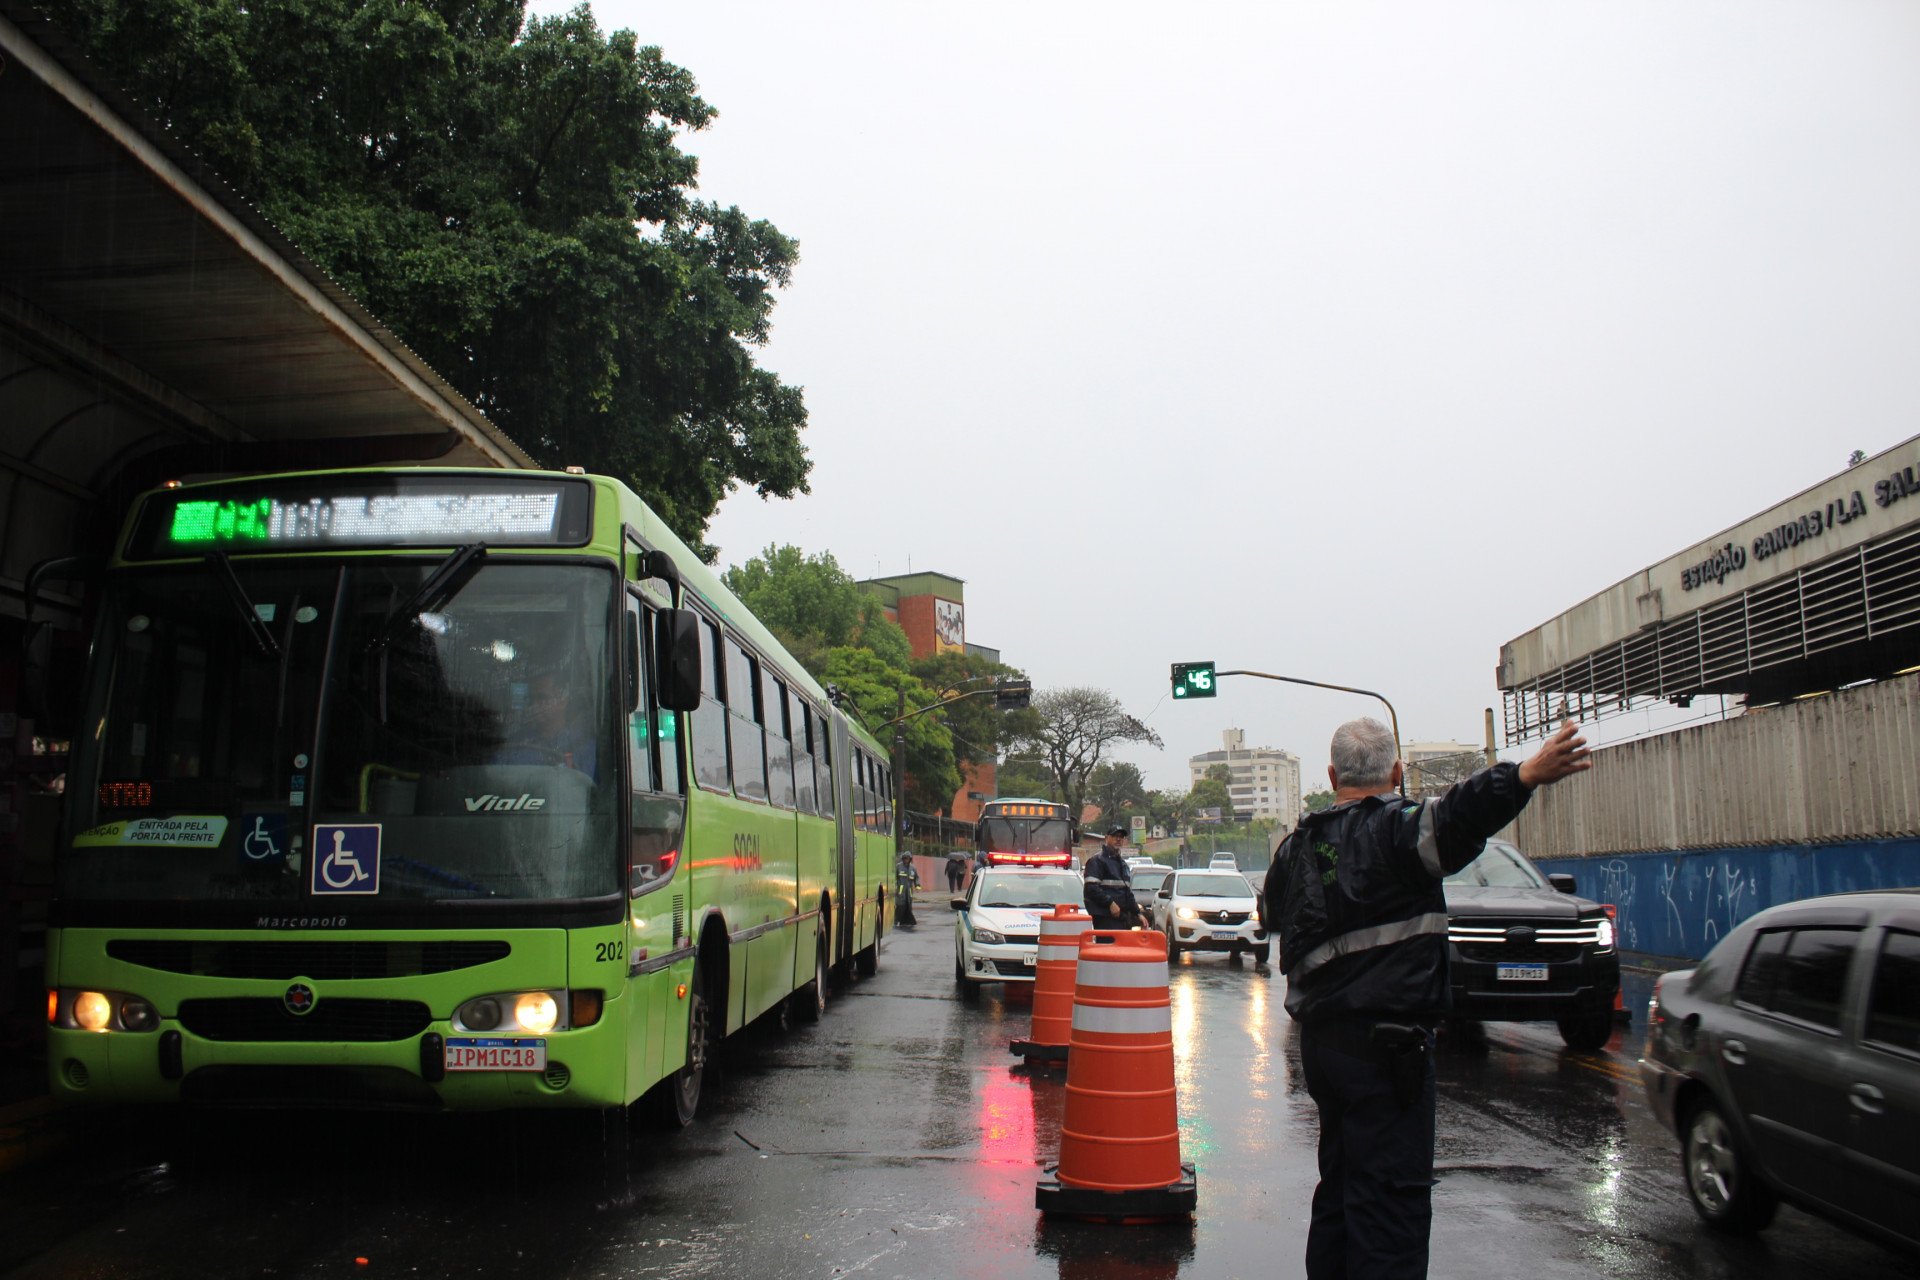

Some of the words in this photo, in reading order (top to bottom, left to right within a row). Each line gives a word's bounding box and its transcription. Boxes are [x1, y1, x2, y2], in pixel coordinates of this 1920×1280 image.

[1681, 543, 1746, 591] ESTAÇÃO
[1188, 670, 1211, 690] 46
[465, 793, 546, 812] Viale
[1002, 804, 1054, 817] CANOAS
[138, 821, 183, 831] ENTRADA
[184, 822, 209, 831] PELA
[130, 831, 162, 841] PORTA
[163, 832, 177, 841] DA
[177, 833, 215, 842] FRENTE
[733, 832, 762, 874] SOGAL
[257, 916, 348, 928] Marcopolo
[595, 941, 623, 962] 202
[454, 1048, 536, 1067] IPM1C18
